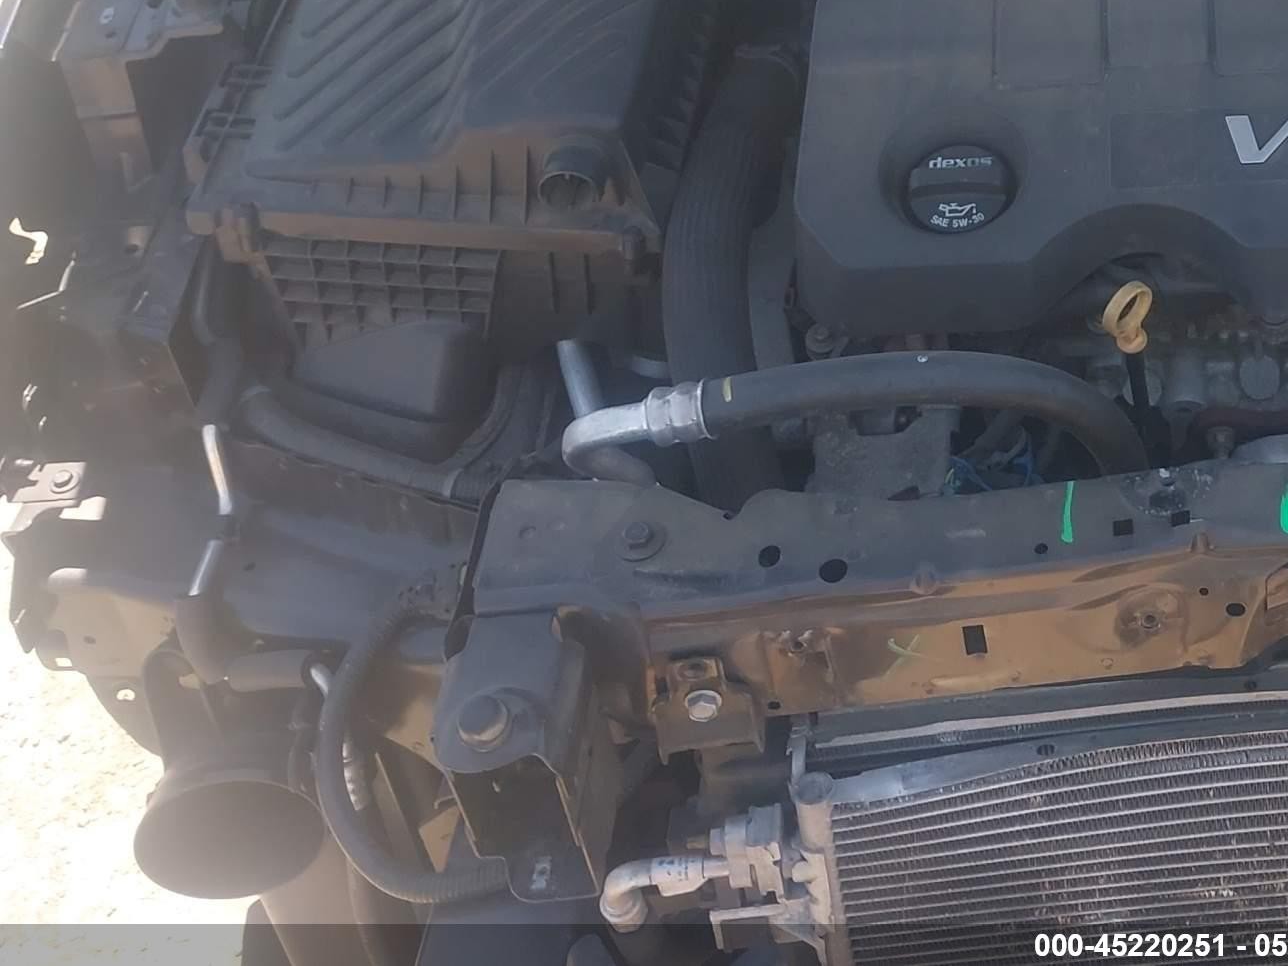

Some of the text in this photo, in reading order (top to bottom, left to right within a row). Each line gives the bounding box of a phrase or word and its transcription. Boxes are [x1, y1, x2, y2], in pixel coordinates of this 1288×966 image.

[928, 157, 993, 169] dexos
[930, 212, 985, 228] SAE 5W-30
